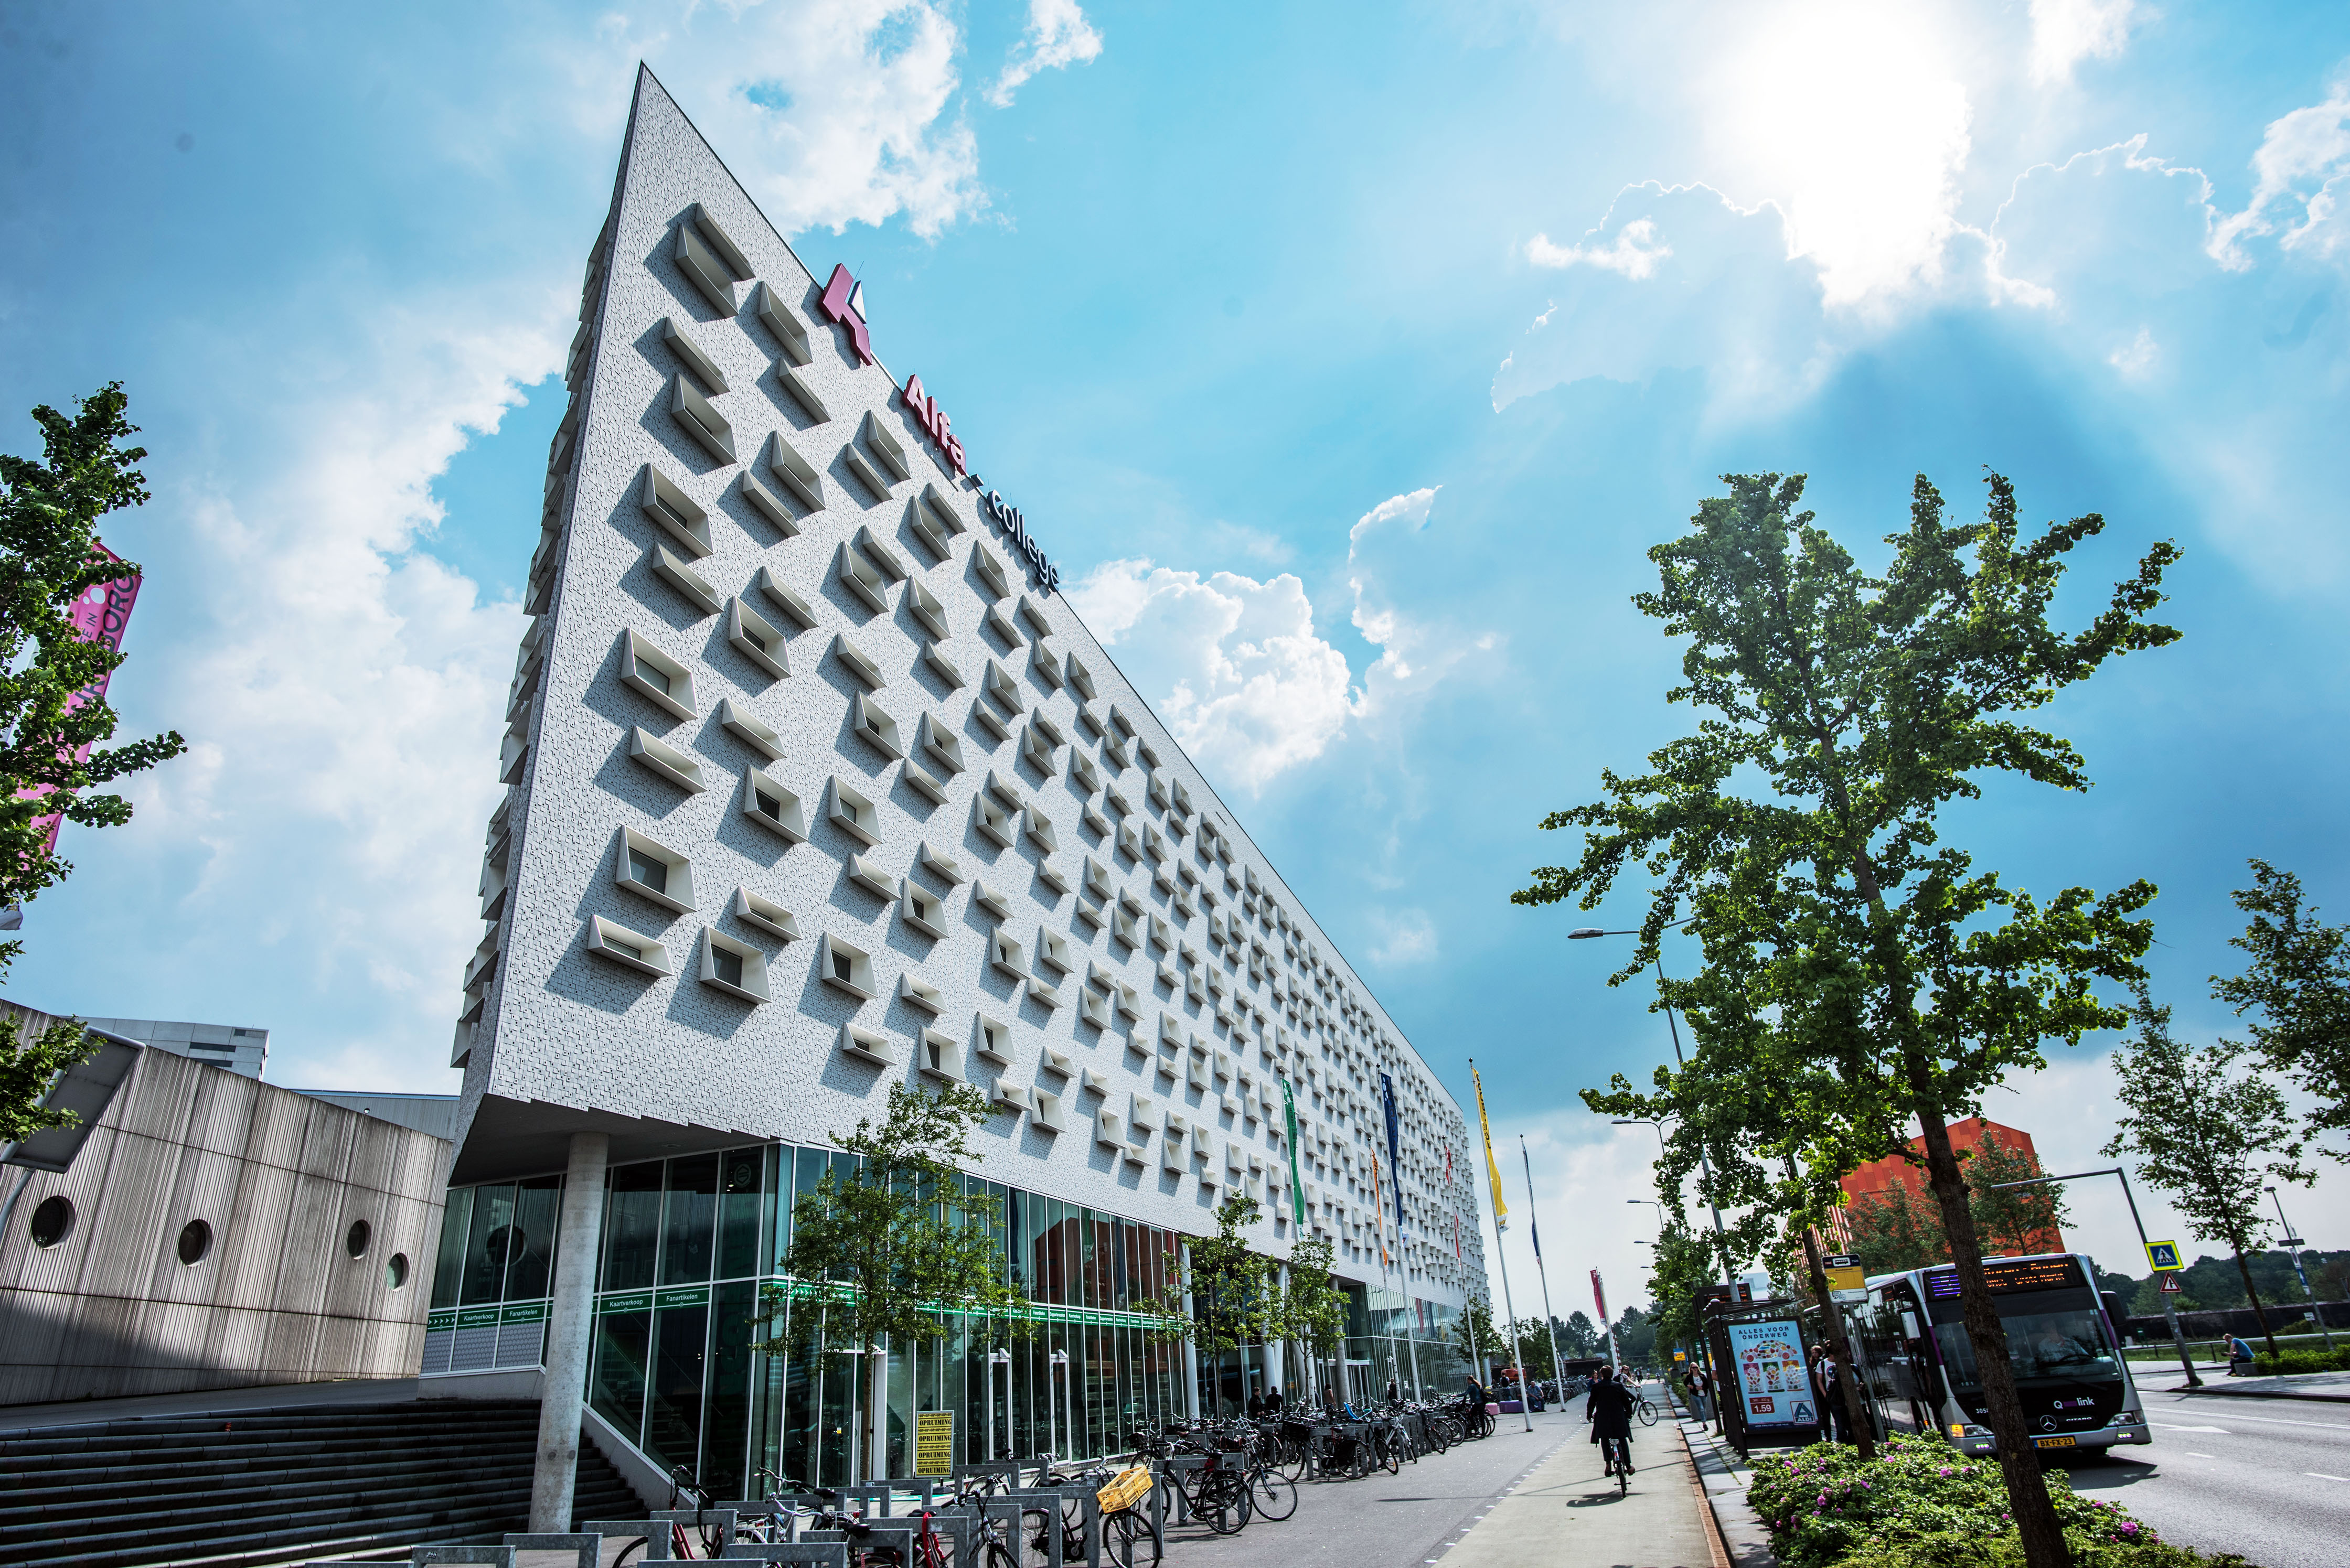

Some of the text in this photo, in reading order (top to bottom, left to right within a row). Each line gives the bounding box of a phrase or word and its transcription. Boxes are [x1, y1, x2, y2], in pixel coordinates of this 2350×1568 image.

[86, 613, 98, 627] IN
[666, 1293, 698, 1302] Fanartikelen
[610, 1299, 643, 1307] Kaartverkoop
[2053, 1397, 2095, 1409] Q link
[1754, 1404, 1771, 1412] 1.59
[2039, 1438, 2073, 1447] BX-FX-23
